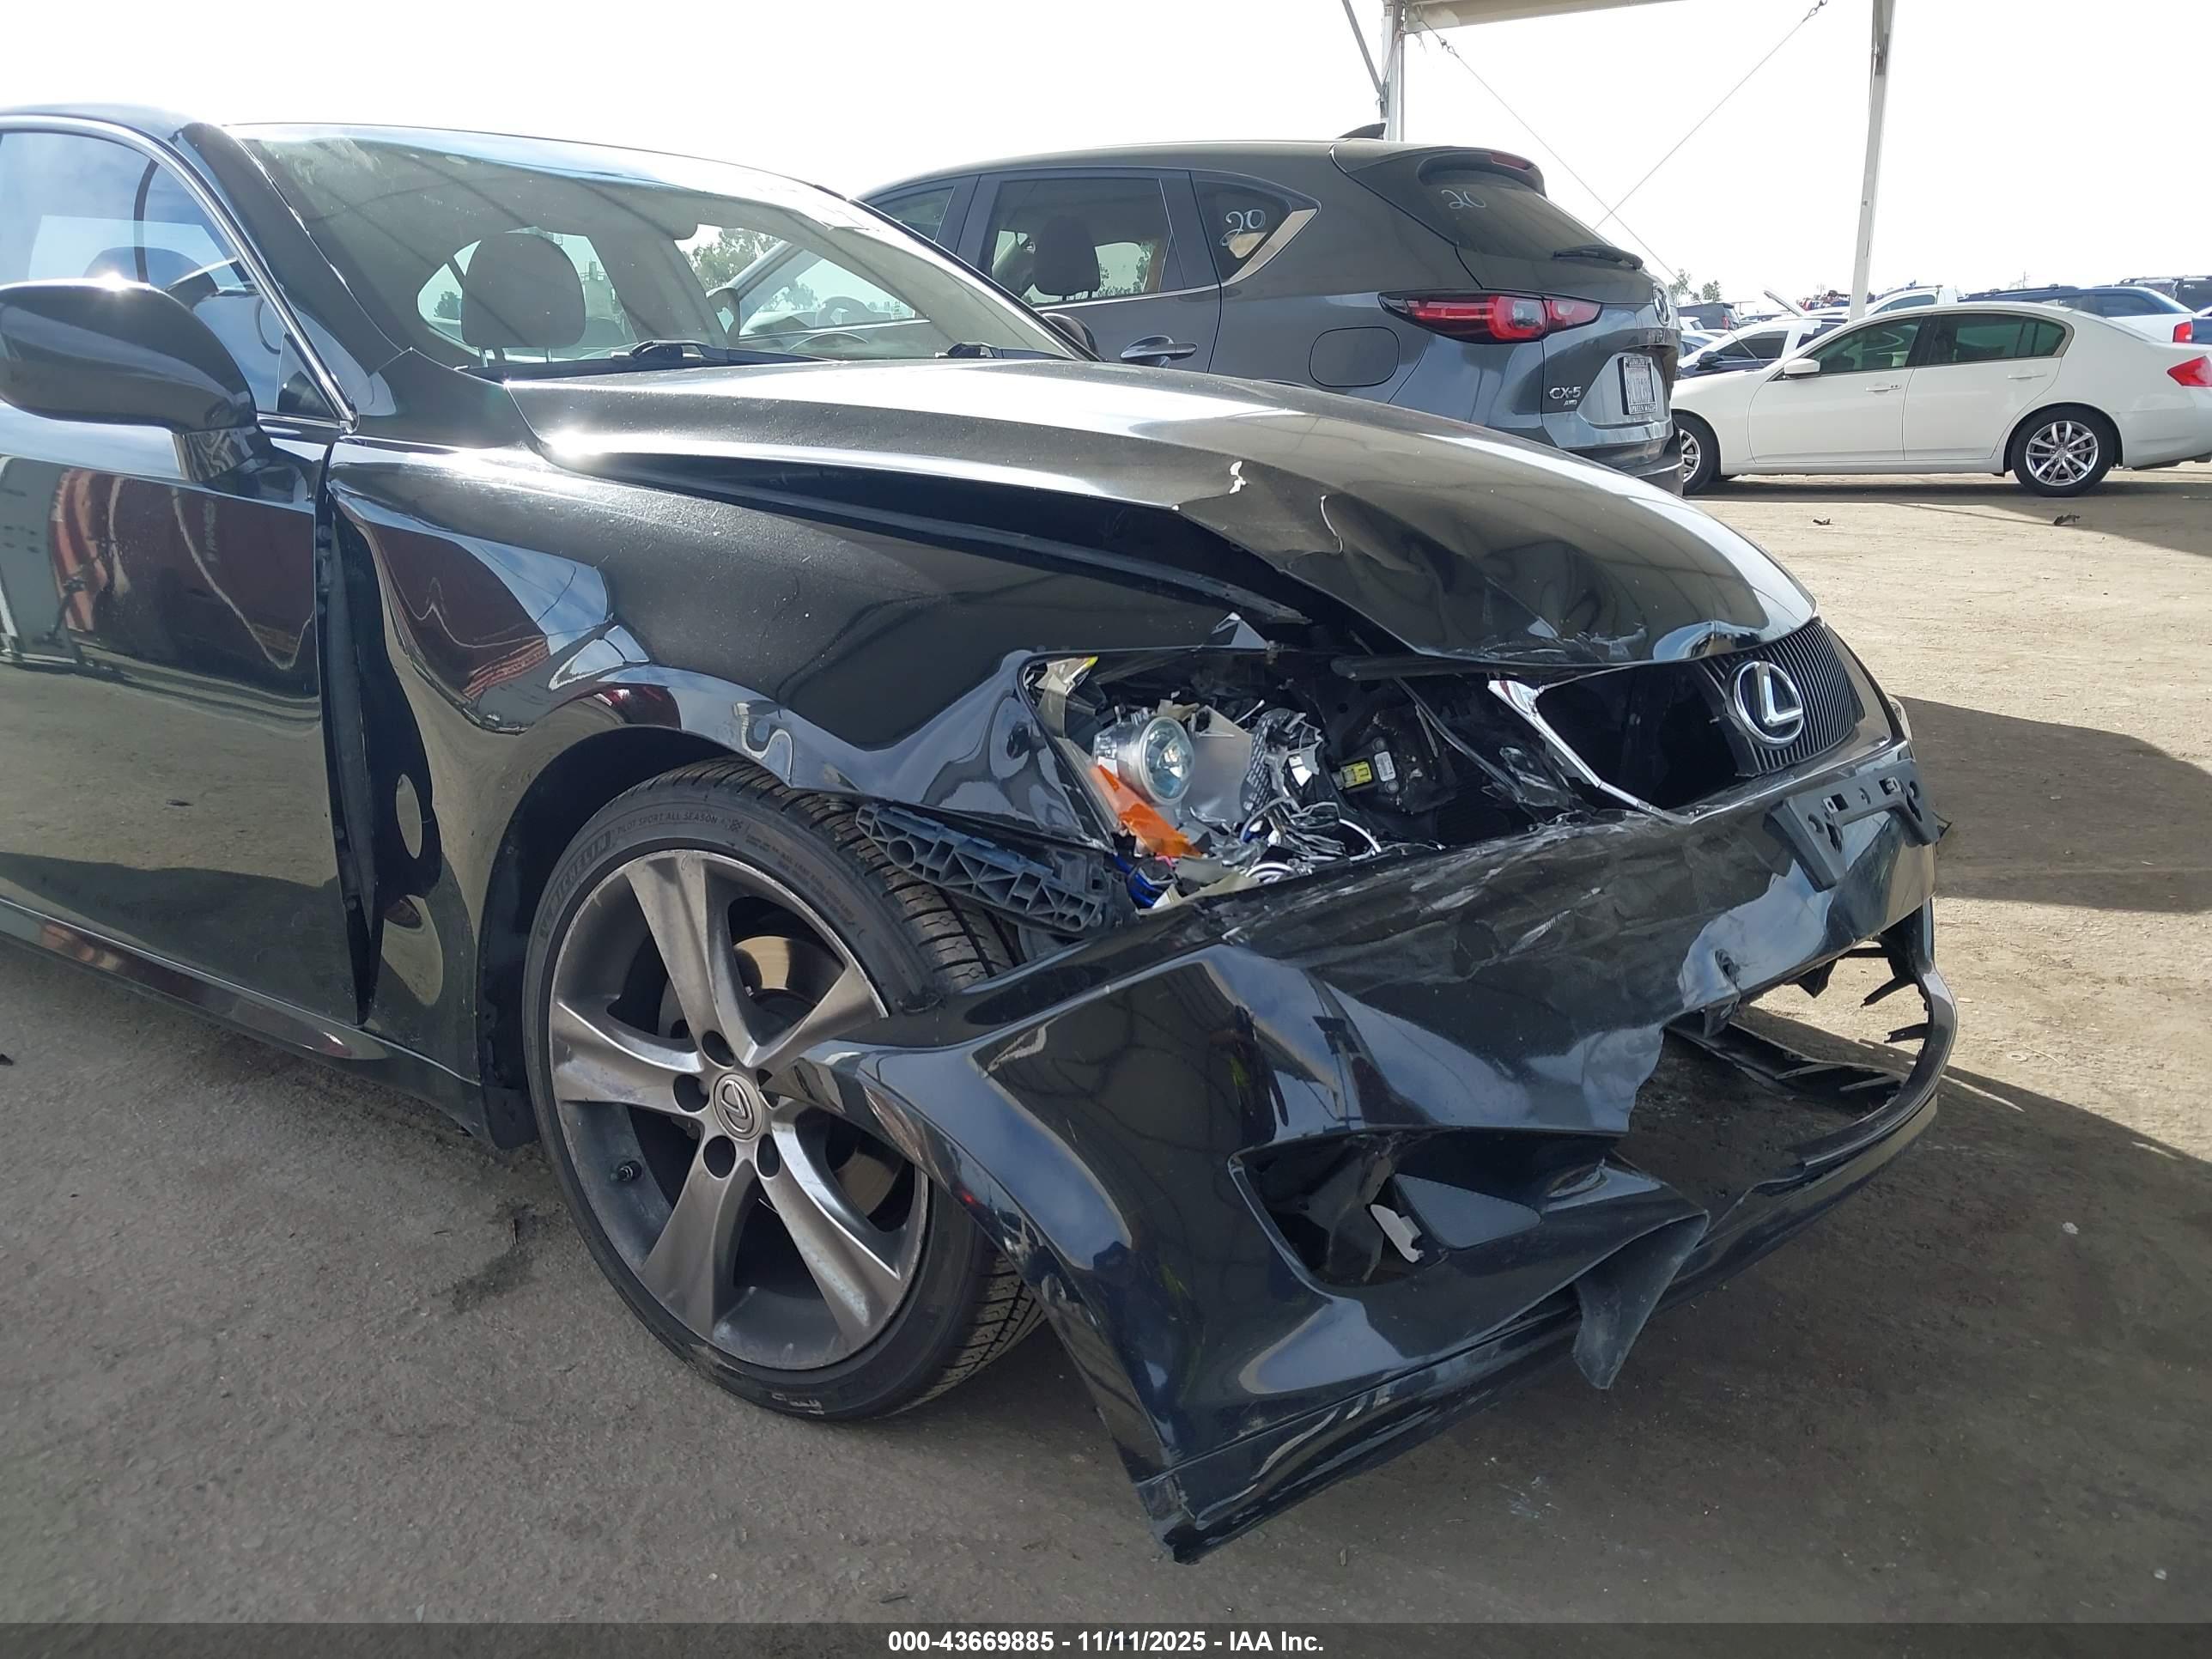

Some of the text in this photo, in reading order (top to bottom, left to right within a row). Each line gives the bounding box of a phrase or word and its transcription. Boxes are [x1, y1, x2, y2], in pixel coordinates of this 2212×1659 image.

[1441, 190, 1486, 209] 20
[1219, 210, 1265, 246] 20
[1549, 386, 1581, 399] CX-5
[638, 813, 664, 826] SPORT
[666, 811, 681, 821] ALL
[683, 811, 718, 823] SEASON
[550, 830, 611, 915] MICHELIN
